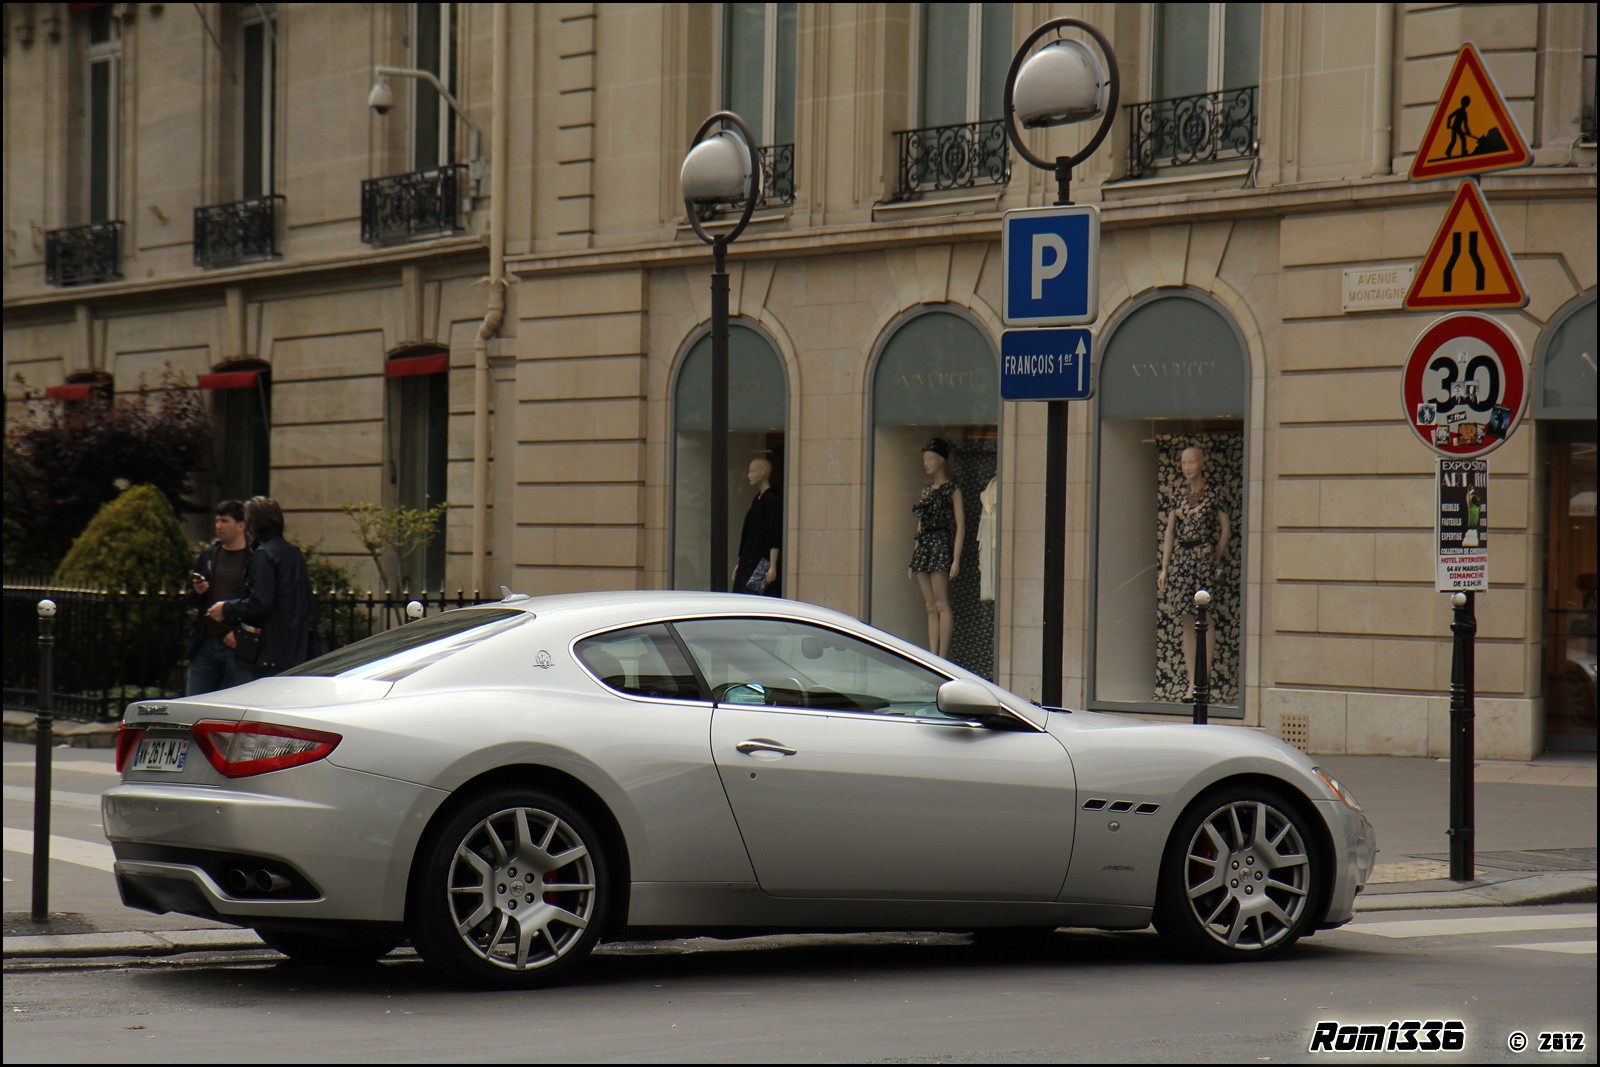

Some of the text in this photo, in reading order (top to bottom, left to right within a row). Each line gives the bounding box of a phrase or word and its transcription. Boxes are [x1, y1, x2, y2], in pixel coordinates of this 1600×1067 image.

[1031, 233, 1068, 299] P
[1358, 272, 1398, 285] AVENUE
[1348, 287, 1406, 301] MONTAIGNE
[1005, 353, 1073, 376] FRANÇOIS 1er
[1427, 355, 1499, 413] 30
